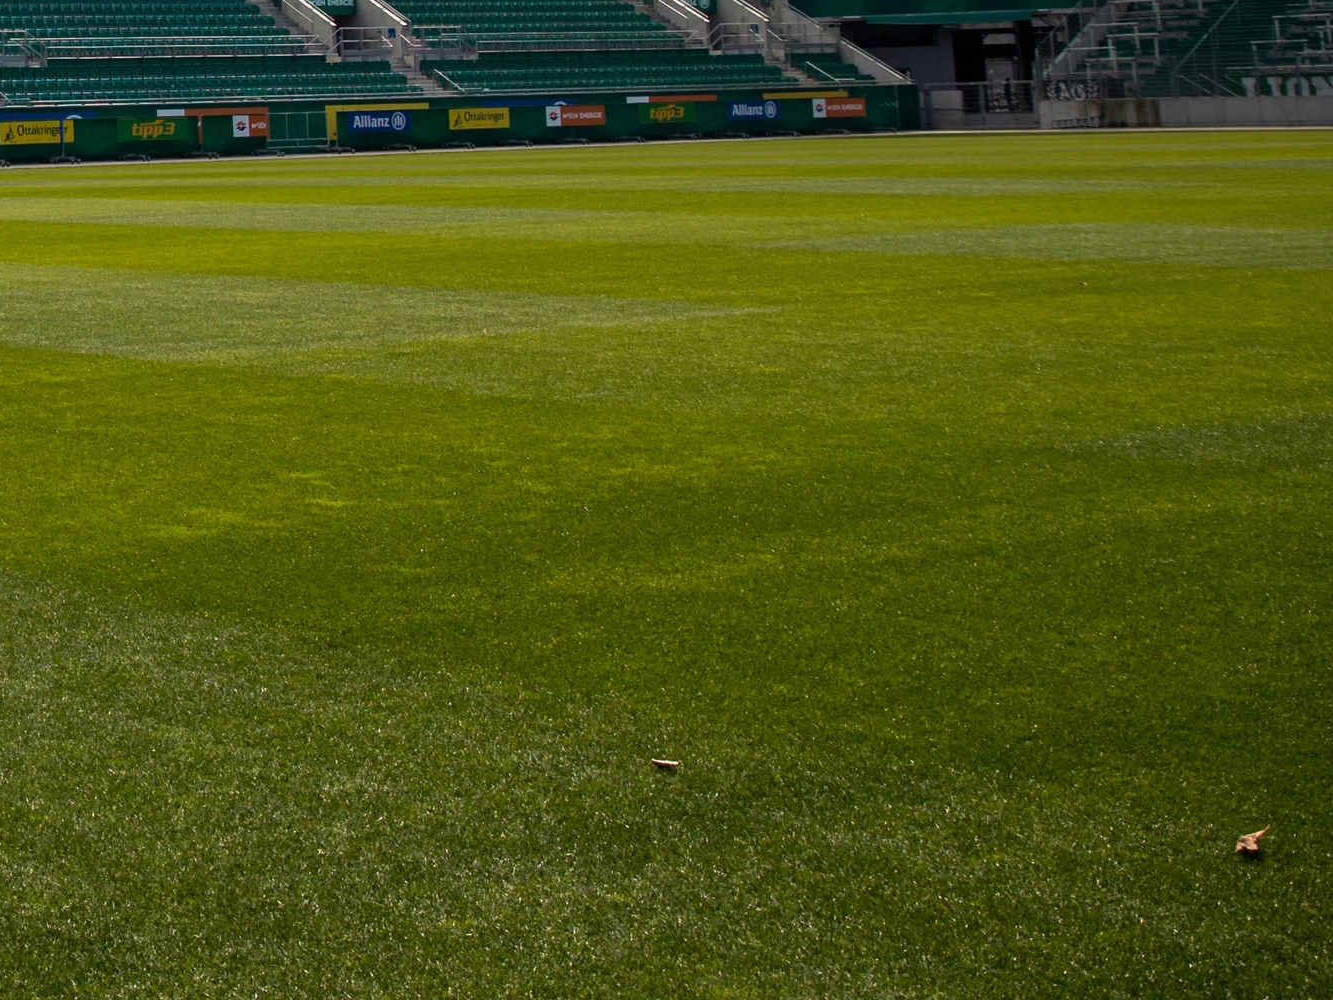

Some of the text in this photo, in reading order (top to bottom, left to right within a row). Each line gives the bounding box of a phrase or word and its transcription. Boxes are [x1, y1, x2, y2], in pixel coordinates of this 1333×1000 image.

[464, 110, 505, 123] Ottakringer
[649, 104, 685, 122] tipp3
[732, 104, 764, 117] Allianz
[352, 114, 390, 128] Allianz
[131, 119, 176, 139] tipp3
